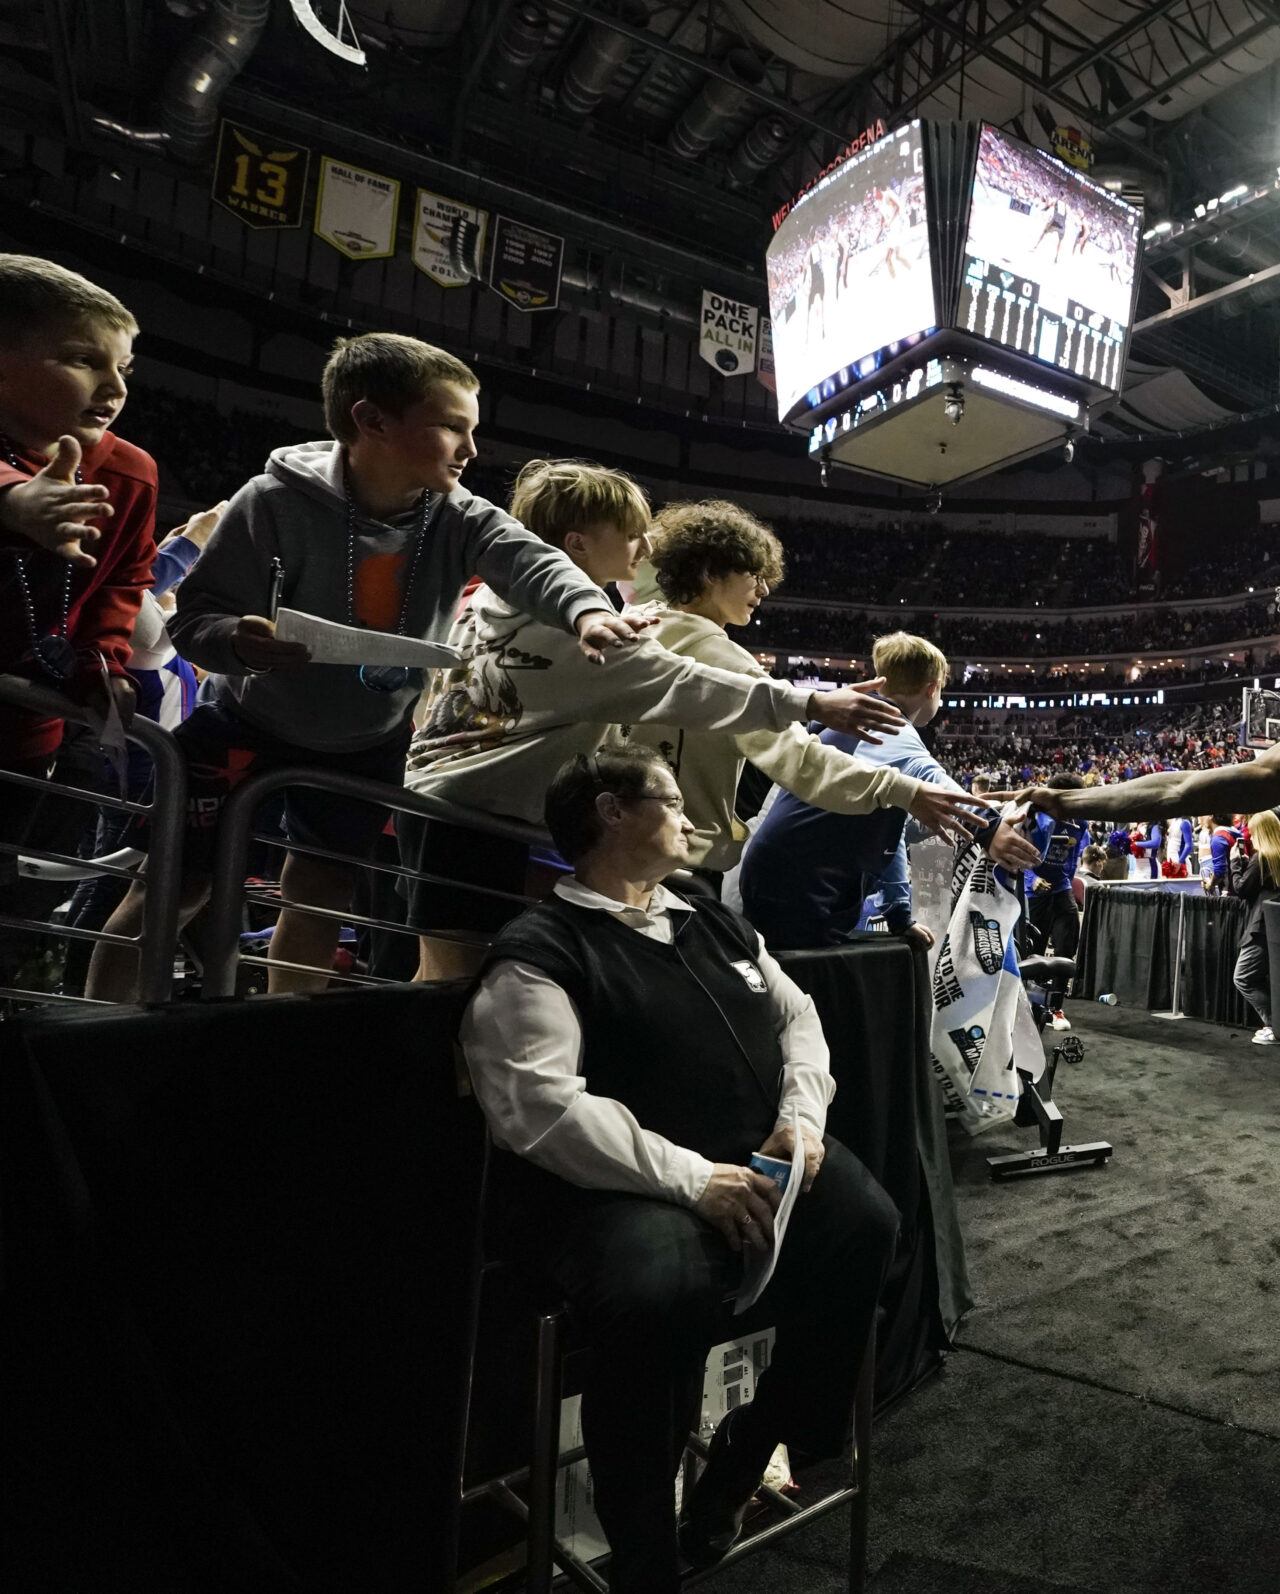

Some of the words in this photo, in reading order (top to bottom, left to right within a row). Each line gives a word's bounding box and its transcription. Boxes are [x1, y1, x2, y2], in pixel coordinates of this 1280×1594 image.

[231, 153, 288, 207] 13
[331, 166, 353, 179] HALL
[355, 173, 366, 183] OF
[367, 179, 391, 192] FAME
[228, 195, 287, 222] WARNER
[437, 201, 469, 219] WORLD
[710, 296, 750, 321] ONE
[703, 309, 753, 339] PACK
[703, 328, 733, 347] ALL
[737, 338, 753, 354] IN
[977, 927, 996, 973] MADNESS
[988, 928, 1003, 957] MARCH
[941, 959, 954, 977] TO
[947, 975, 965, 1003] THE
[1031, 1155, 1075, 1167] ROGUE
